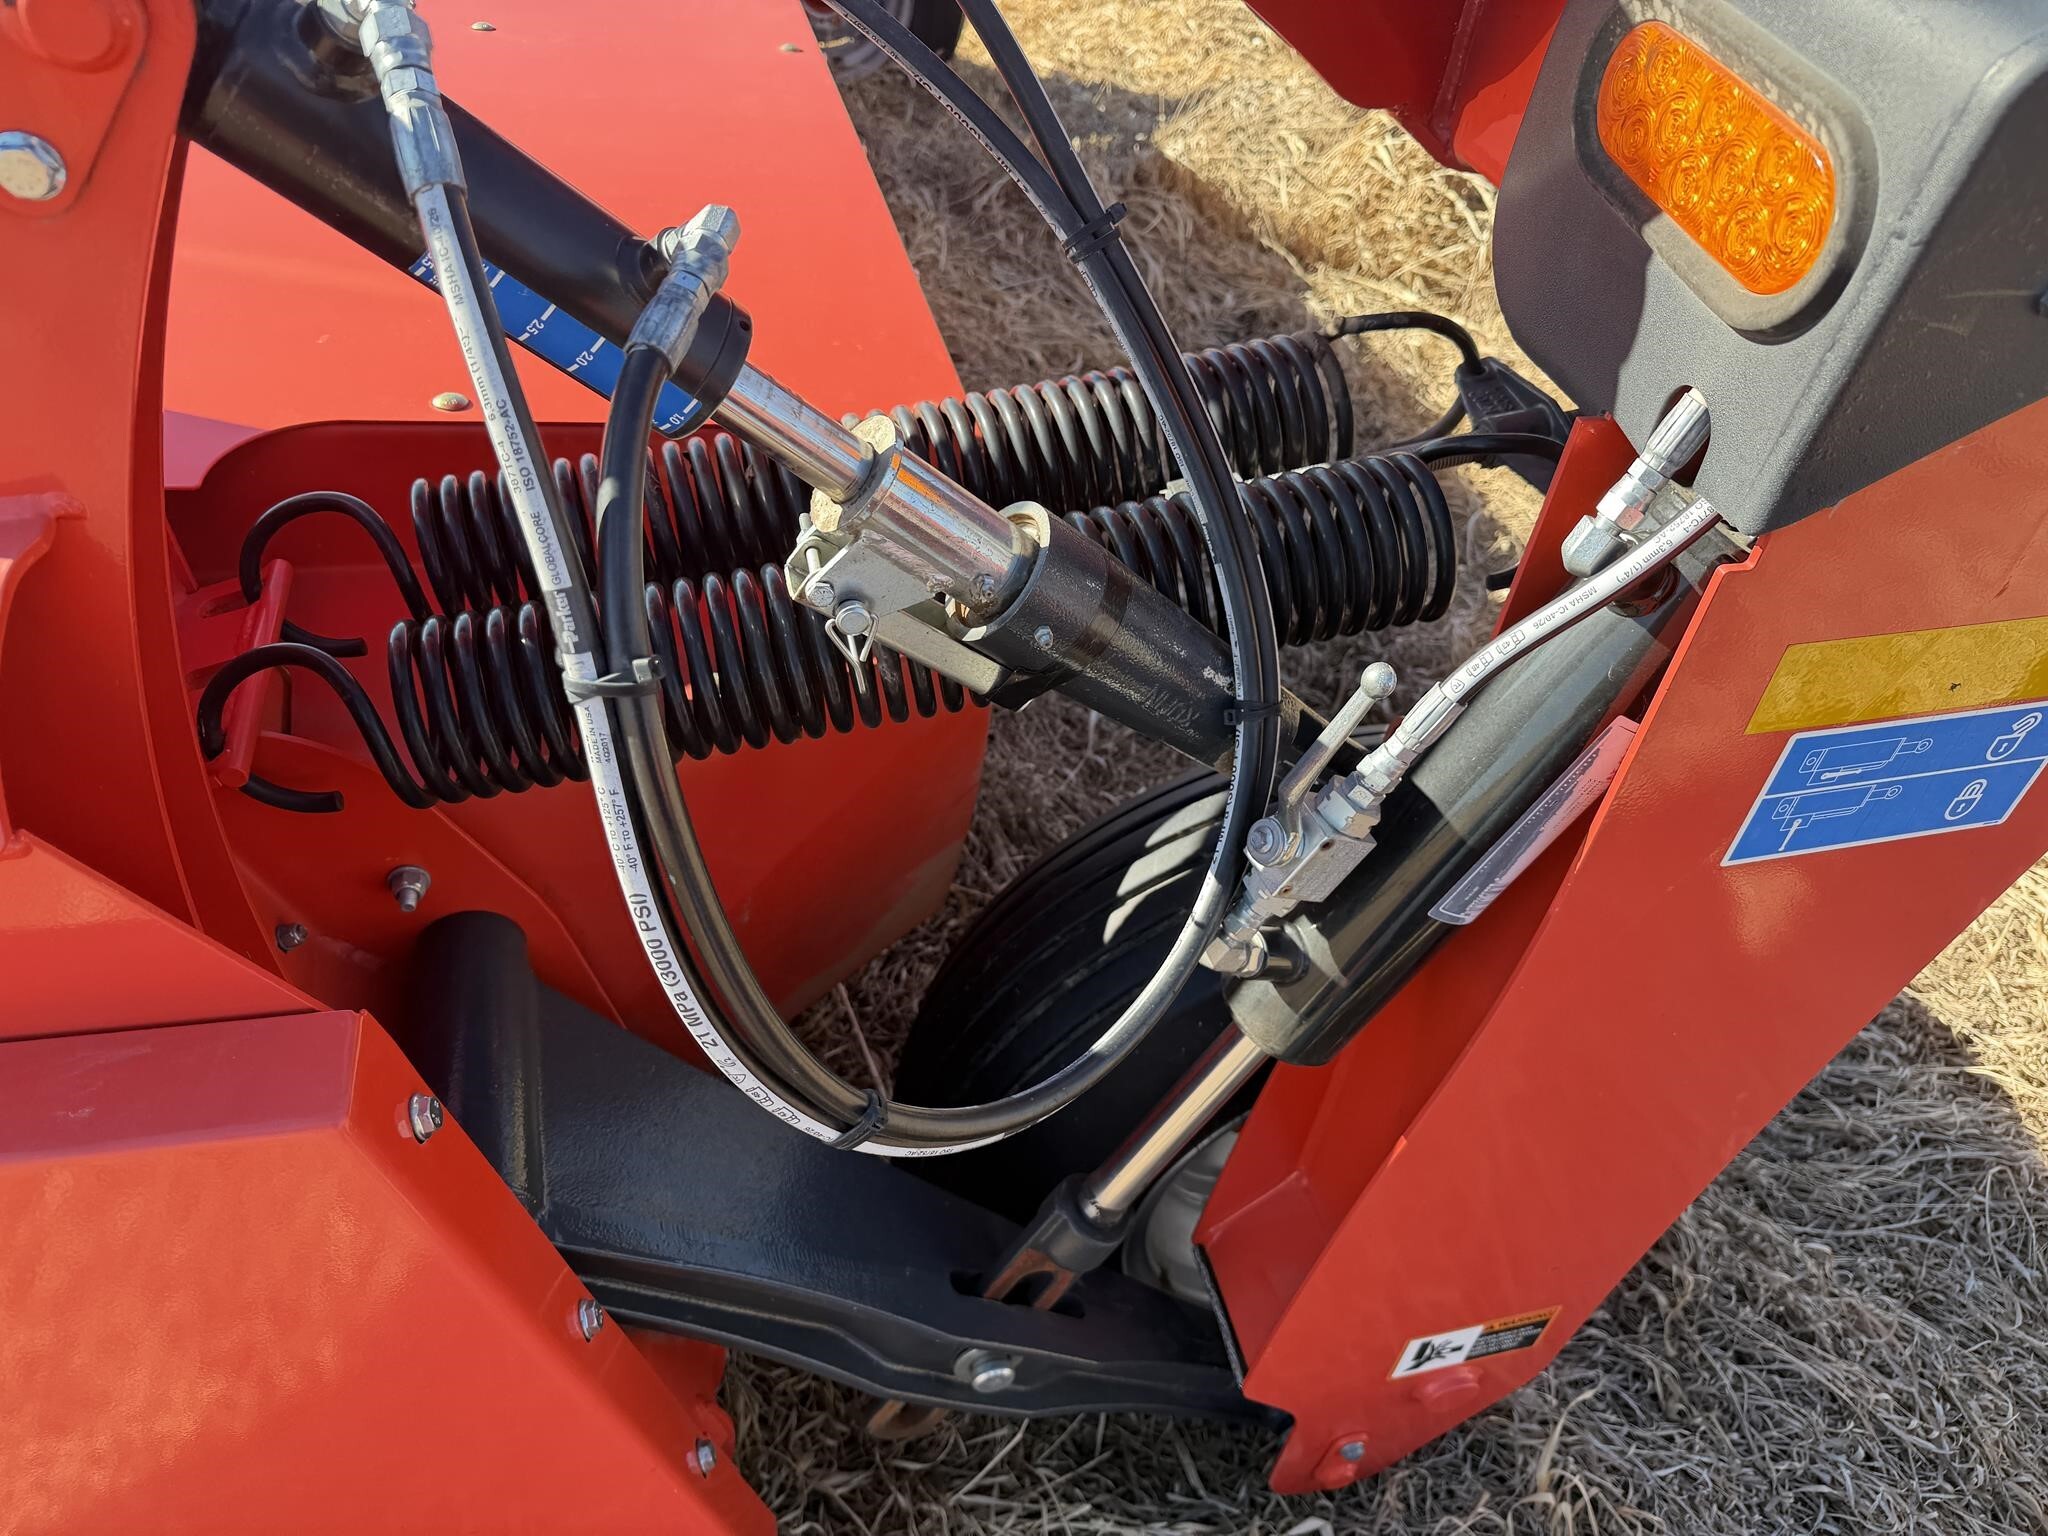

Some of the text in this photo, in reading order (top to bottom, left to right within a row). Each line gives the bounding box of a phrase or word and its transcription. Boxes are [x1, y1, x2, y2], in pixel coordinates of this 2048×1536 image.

[495, 396, 525, 463] 18752-AC
[518, 465, 536, 491] ISO
[1682, 504, 1715, 533] 87TC-4
[1568, 586, 1597, 607] MSHA
[1532, 603, 1568, 629] IC-40/26
[582, 705, 594, 725] USA
[608, 787, 619, 796] F
[620, 829, 631, 841] TO
[628, 893, 718, 1049] 21 MPa (3000 PSI)
